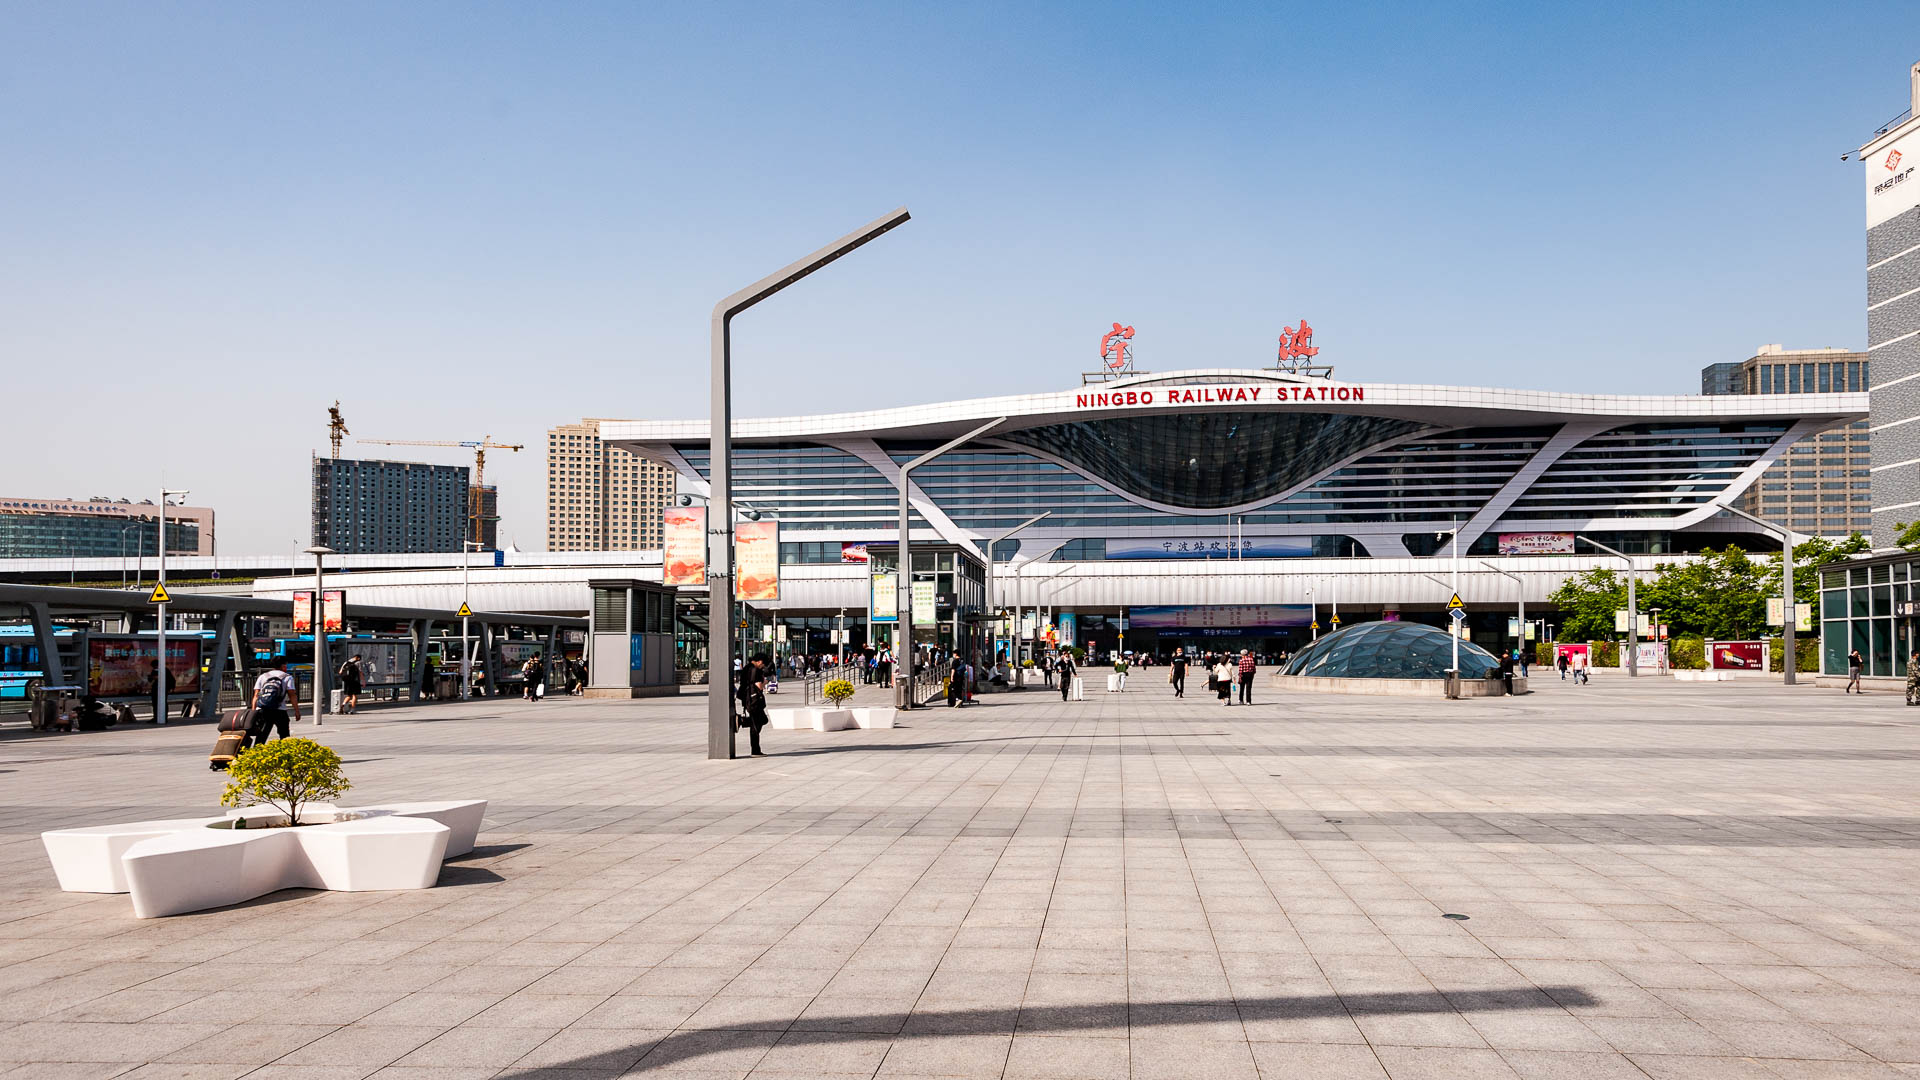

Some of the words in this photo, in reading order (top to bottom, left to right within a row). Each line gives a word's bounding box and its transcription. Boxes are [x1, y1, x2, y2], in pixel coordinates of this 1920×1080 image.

[1101, 323, 1135, 368] 宁
[1279, 320, 1320, 360] 波
[1077, 391, 1153, 408] NINGBO
[1168, 387, 1261, 404] RAILWAY
[1277, 387, 1364, 401] STATION
[1163, 541, 1253, 552] 宁波站欢迎您
